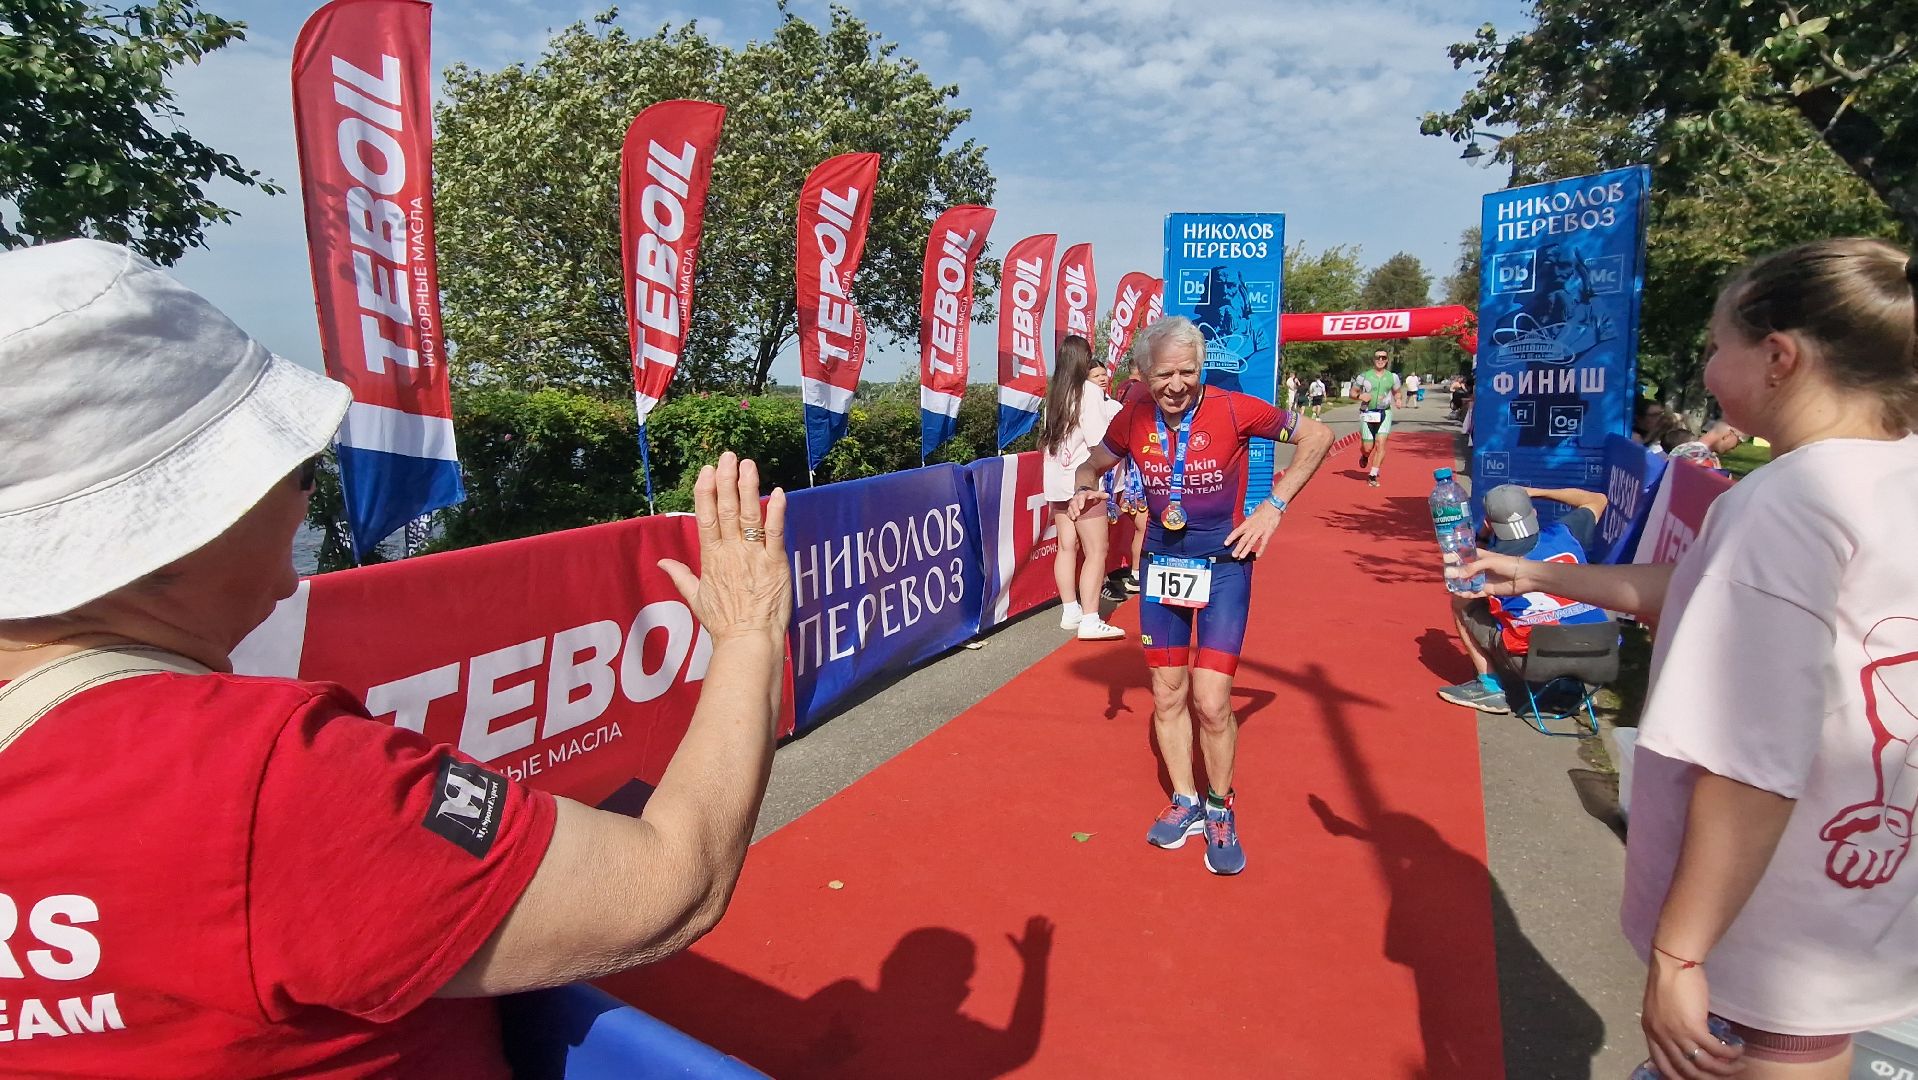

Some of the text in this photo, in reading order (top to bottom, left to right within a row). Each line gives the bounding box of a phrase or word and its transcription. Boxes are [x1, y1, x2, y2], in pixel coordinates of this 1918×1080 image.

[332, 54, 419, 375] TEBOIL
[1497, 181, 1625, 222] НИКОЛОВ
[1183, 223, 1274, 240] НИКОЛОВ
[1497, 206, 1616, 242] ПЕРЕВОЗ
[636, 139, 697, 370] TEBOIL
[1183, 241, 1268, 259] ПЕРЕВОЗ
[409, 196, 435, 368] МОТОРНЫЕ МАСЛА
[680, 248, 694, 295] МАСЛА
[1499, 264, 1529, 283] Db
[1589, 269, 1617, 285] Mc
[1183, 280, 1206, 295] Db
[1248, 291, 1269, 304] Mc
[929, 228, 977, 376] TEBOIL
[1012, 256, 1043, 379] TEBOIL
[1329, 315, 1403, 331] TEBOIL
[1493, 367, 1605, 395] ФИНИШ
[1554, 415, 1578, 430] Og
[1144, 457, 1217, 473] Polonkin
[1486, 459, 1505, 470] No
[1196, 483, 1223, 494] TEAM
[794, 503, 964, 608] НИКОЛОВ
[1157, 571, 1199, 598] 157
[798, 557, 964, 677] ПЕРЕВОЗ
[548, 721, 623, 768] МАСЛА
